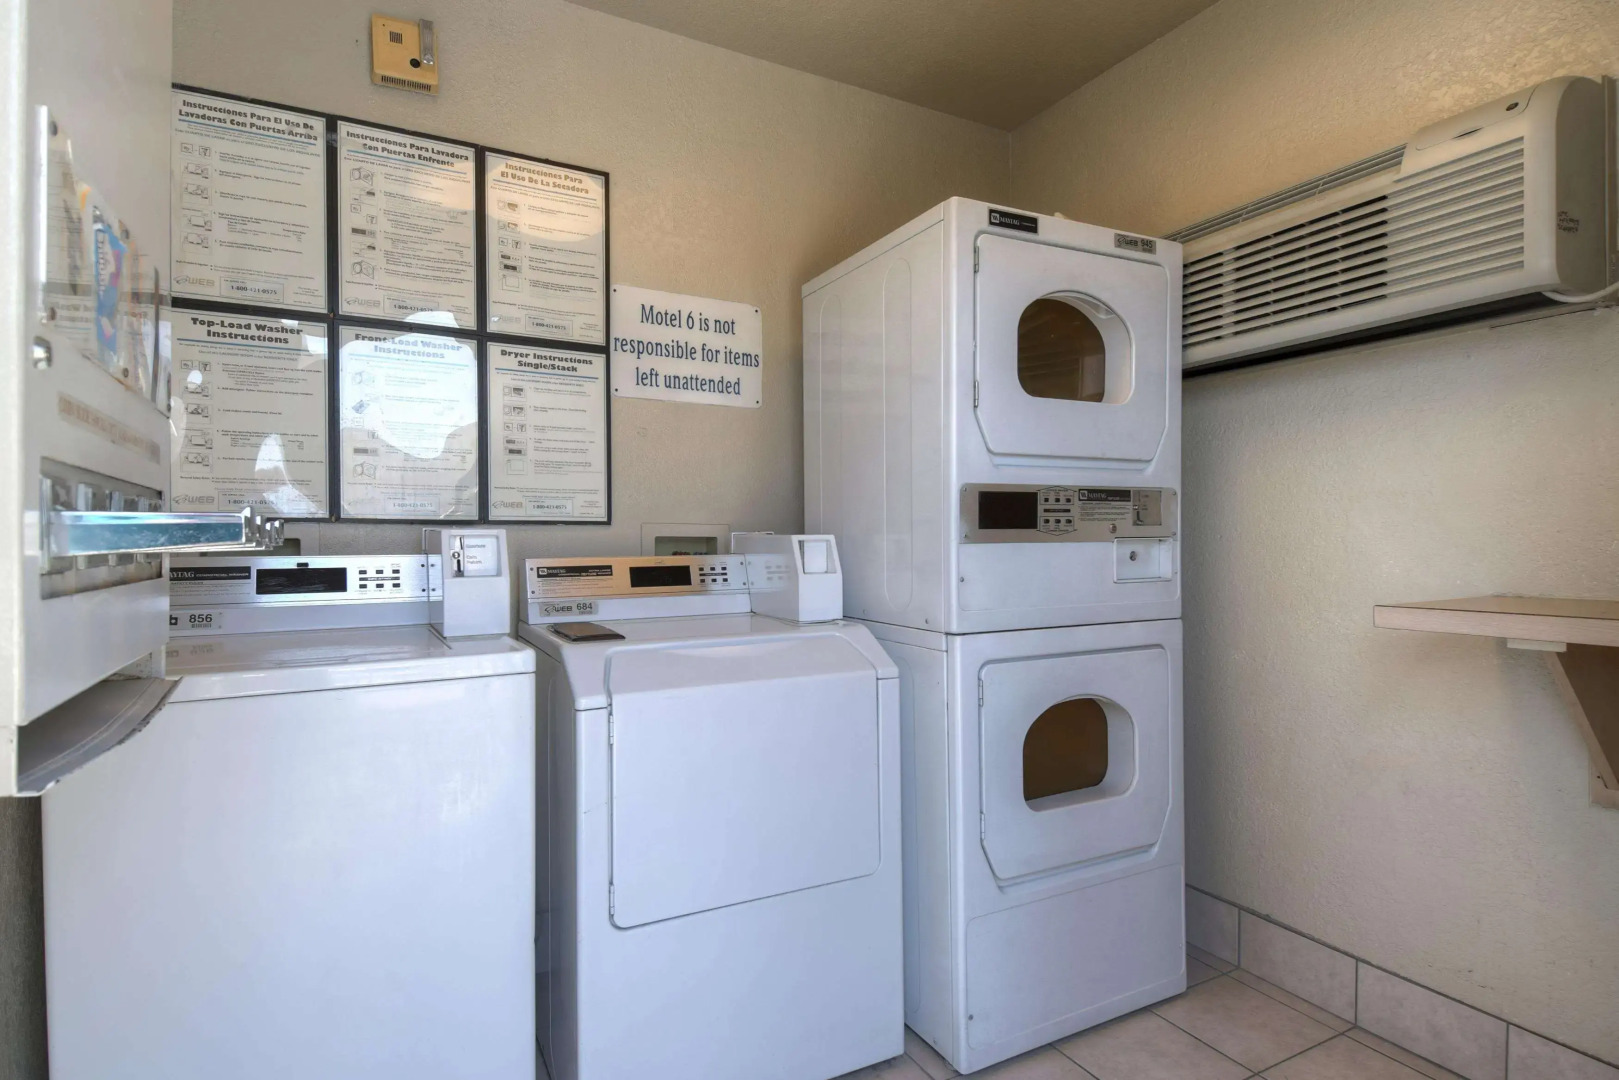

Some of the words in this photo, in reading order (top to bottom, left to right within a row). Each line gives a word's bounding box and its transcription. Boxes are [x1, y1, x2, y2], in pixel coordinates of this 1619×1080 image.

[183, 99, 247, 118] Instrucciones
[250, 112, 271, 123] Para
[274, 116, 282, 125] El
[285, 119, 300, 128] Uso
[303, 122, 314, 131] De
[178, 109, 227, 124] Lavadoras
[230, 118, 247, 128] Con
[250, 122, 286, 135] Puertas
[287, 128, 318, 141] Arriba
[346, 130, 407, 149] Instrucciones
[409, 143, 429, 153] Para
[432, 147, 469, 161] Lavadora
[362, 143, 379, 152] Con
[381, 146, 416, 160] Puertas
[418, 154, 455, 168] Enfrente
[500, 170, 509, 179] El
[511, 172, 526, 182] Uso
[528, 176, 539, 185] De
[541, 179, 551, 187] La
[552, 181, 590, 195] Secadora
[505, 162, 562, 180] Instrucciones
[564, 174, 583, 185] Para
[1140, 239, 1153, 249] 945
[187, 276, 215, 287] WEB
[190, 317, 252, 331] Top-Load
[254, 323, 304, 335] Washer
[640, 303, 682, 329] Motel
[686, 310, 695, 330] 6
[699, 312, 710, 332] is
[713, 318, 736, 335] not
[206, 329, 289, 344] Instructions
[354, 333, 418, 347] Front-Load
[420, 340, 463, 352] Washer
[373, 345, 446, 359] Instructions
[500, 349, 531, 359] Dryer
[533, 352, 594, 365] Instructions
[613, 336, 697, 361] responsible
[701, 343, 720, 363] for
[724, 346, 760, 368] items
[517, 360, 578, 373] Single/Stack
[635, 366, 660, 388] left
[663, 372, 741, 396] unattended
[576, 602, 593, 611] 684
[188, 613, 213, 624] 856
